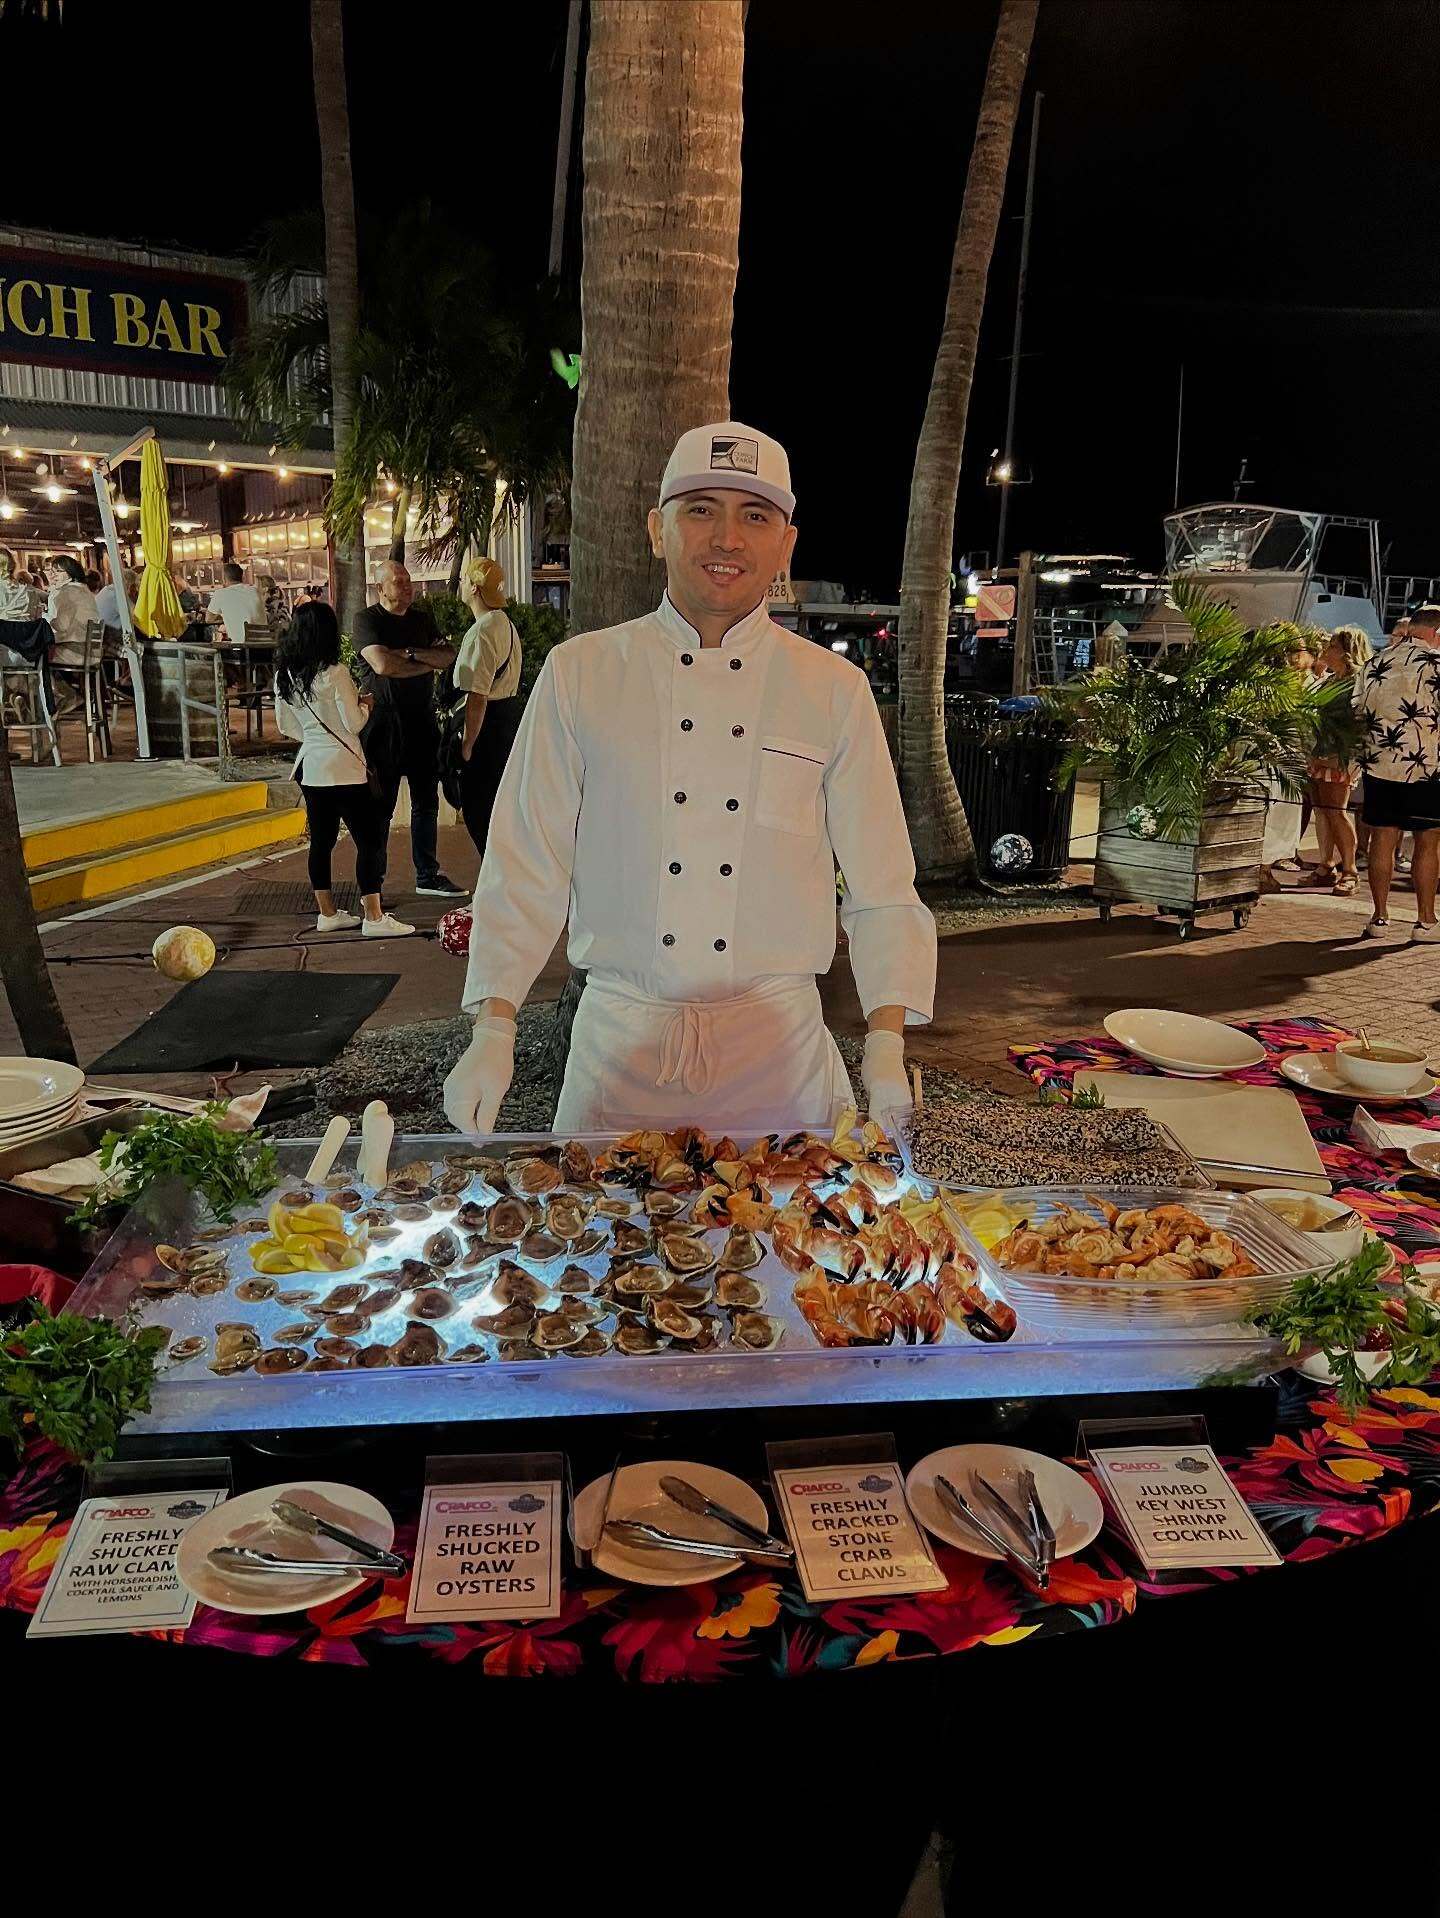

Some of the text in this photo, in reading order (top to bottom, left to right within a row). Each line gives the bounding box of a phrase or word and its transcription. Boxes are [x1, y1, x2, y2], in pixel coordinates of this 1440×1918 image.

[0, 278, 227, 357] CH BAR
[767, 584, 787, 597] 828
[790, 1482, 843, 1496] CRAFCO
[1140, 1484, 1207, 1496] JUMBO
[810, 1498, 888, 1515] FRESHLY
[1135, 1498, 1226, 1511] KEY WEST
[811, 1514, 899, 1531] CRACKED
[1153, 1513, 1227, 1527] SHRIMP
[101, 1528, 184, 1544] FRESHLY
[445, 1522, 537, 1538] FRESHLY
[1152, 1529, 1248, 1542] COCKTAIL
[828, 1531, 893, 1547] STONE
[436, 1540, 540, 1556] SHUCKED
[840, 1548, 892, 1563] CRAB
[69, 1563, 119, 1577] RAW
[460, 1560, 515, 1575] RAW
[837, 1564, 907, 1582] CLAWS
[67, 1583, 179, 1597] COCKTAIL SAUCE AND
[73, 1580, 100, 1588] WITH
[436, 1577, 536, 1596] OYSTERS
[97, 1594, 143, 1603] LEMONS
